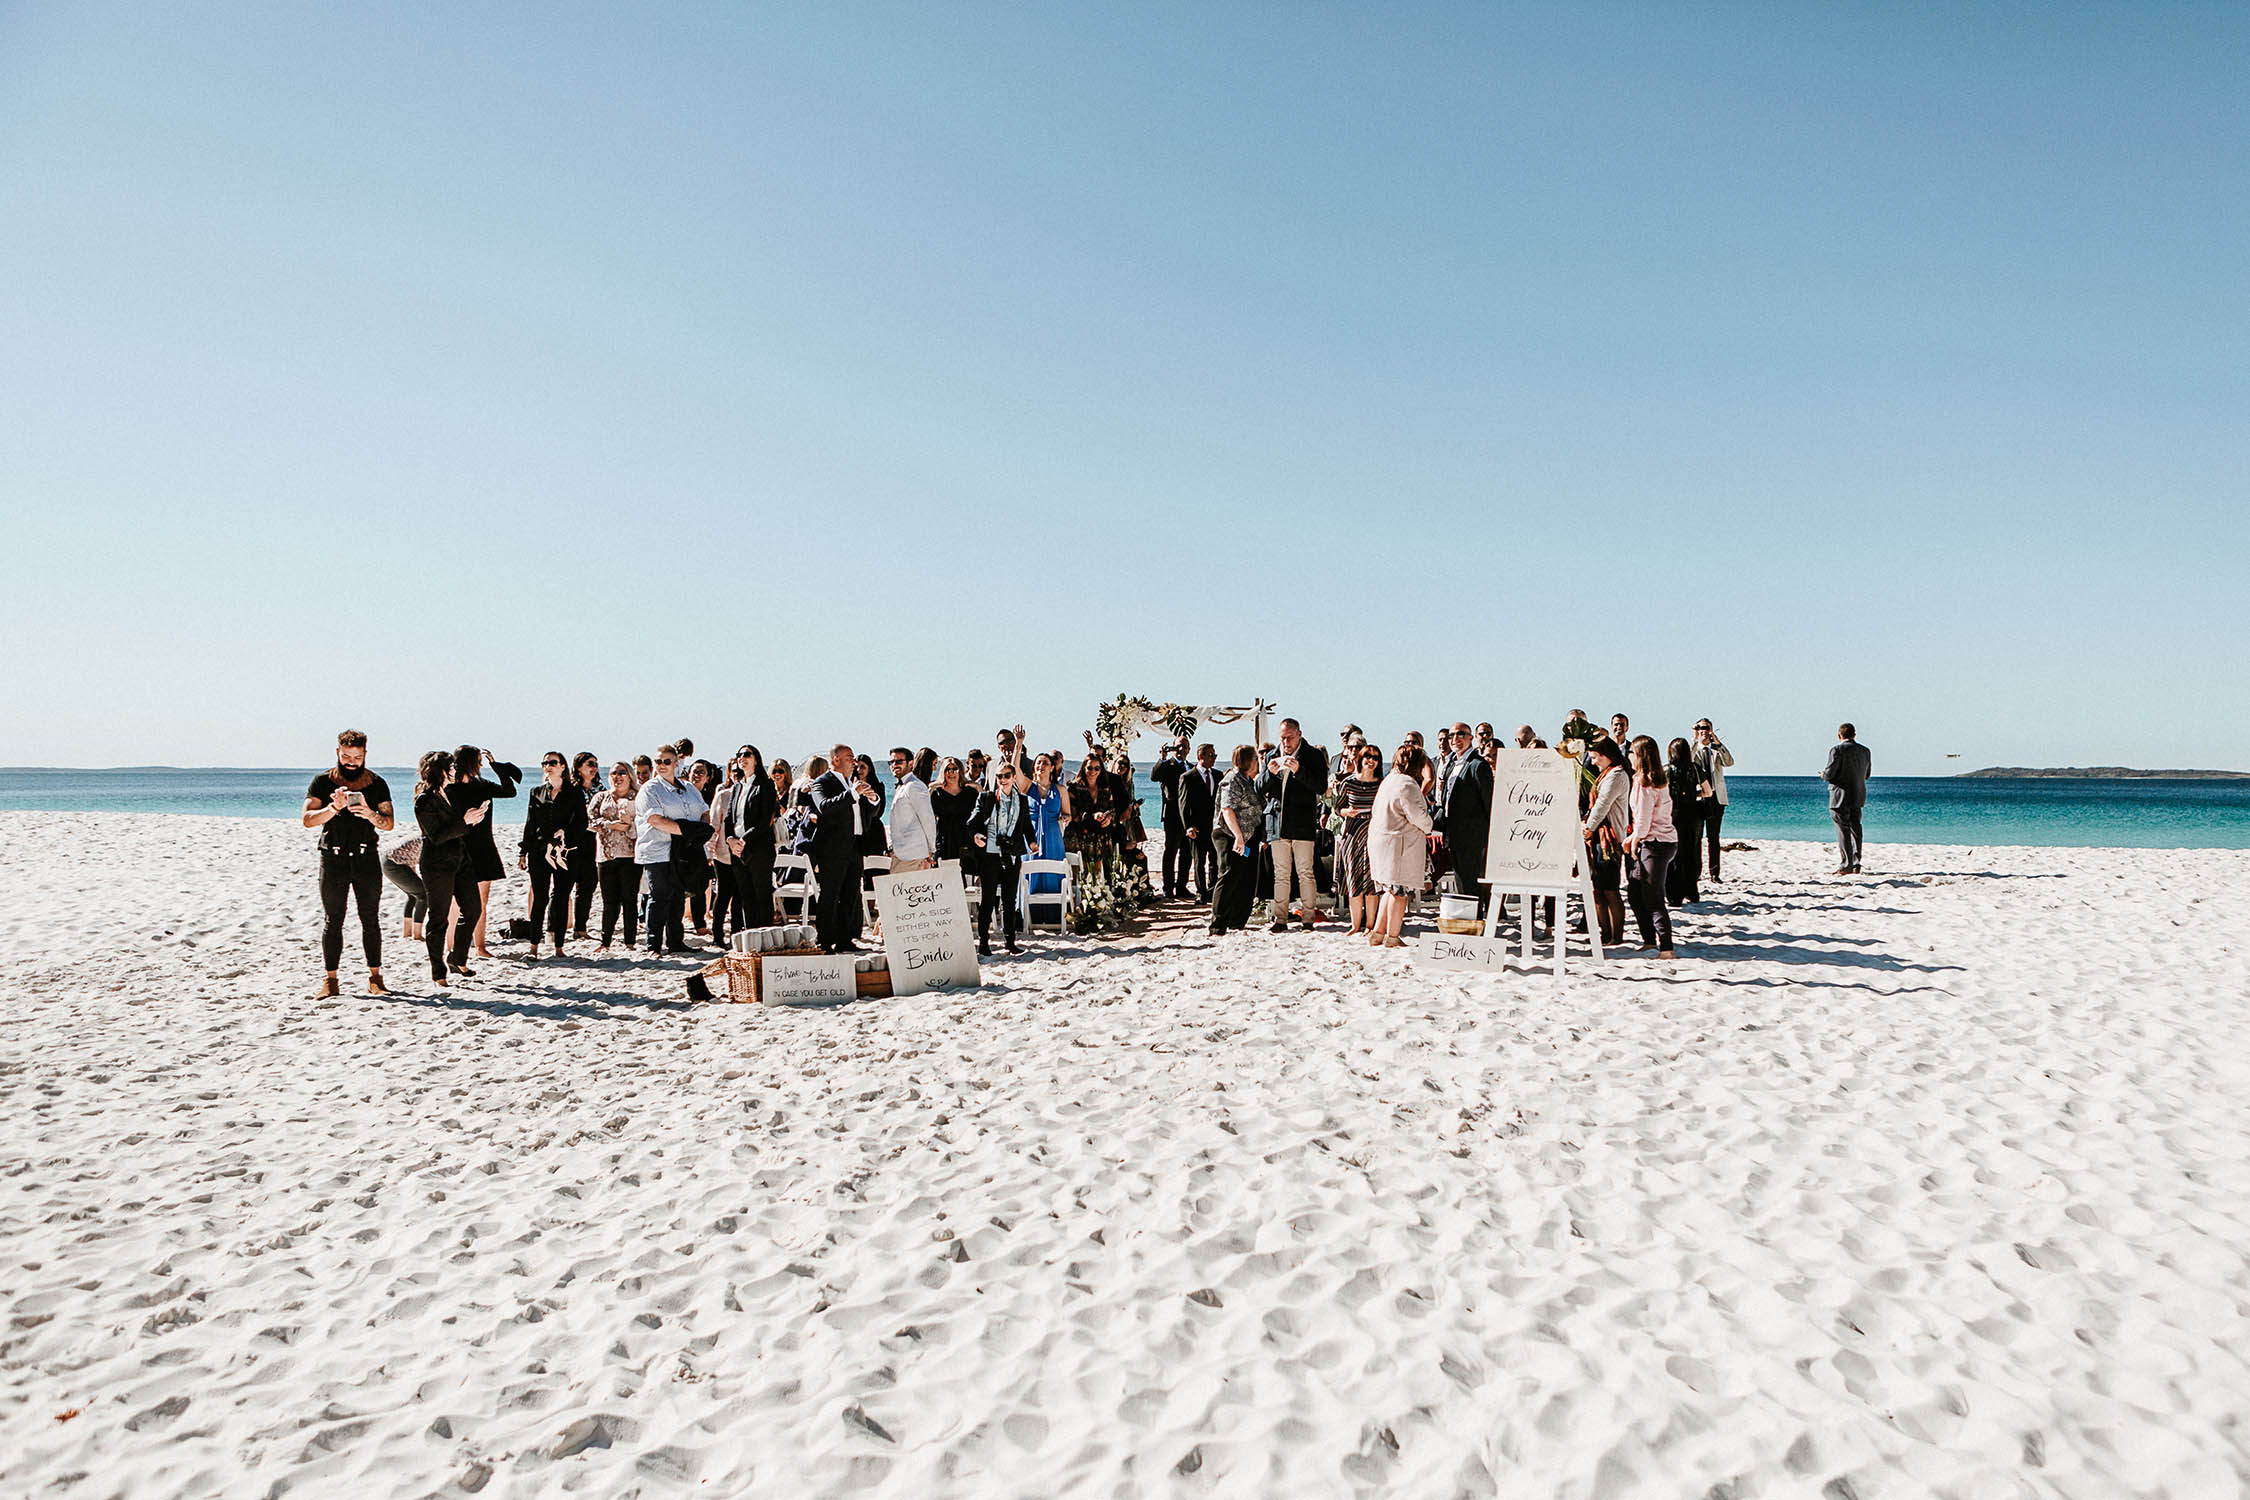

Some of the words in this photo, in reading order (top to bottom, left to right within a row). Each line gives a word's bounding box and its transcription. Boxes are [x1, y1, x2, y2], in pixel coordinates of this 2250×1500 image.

[1523, 806, 1547, 816] and
[892, 882, 933, 897] Choose
[905, 893, 938, 908] Seat
[896, 912, 915, 921] NOT
[929, 907, 953, 917] SIDE
[896, 922, 930, 933] EITHER
[935, 919, 953, 927] WAY
[921, 932, 939, 941] FOR
[1430, 940, 1477, 961] Brides
[904, 947, 953, 970] Bride
[783, 966, 801, 979] have
[818, 969, 841, 981] hold
[781, 990, 799, 998] CASE
[800, 989, 814, 997] YOU
[815, 989, 828, 997] GET
[830, 988, 846, 996] OLD
